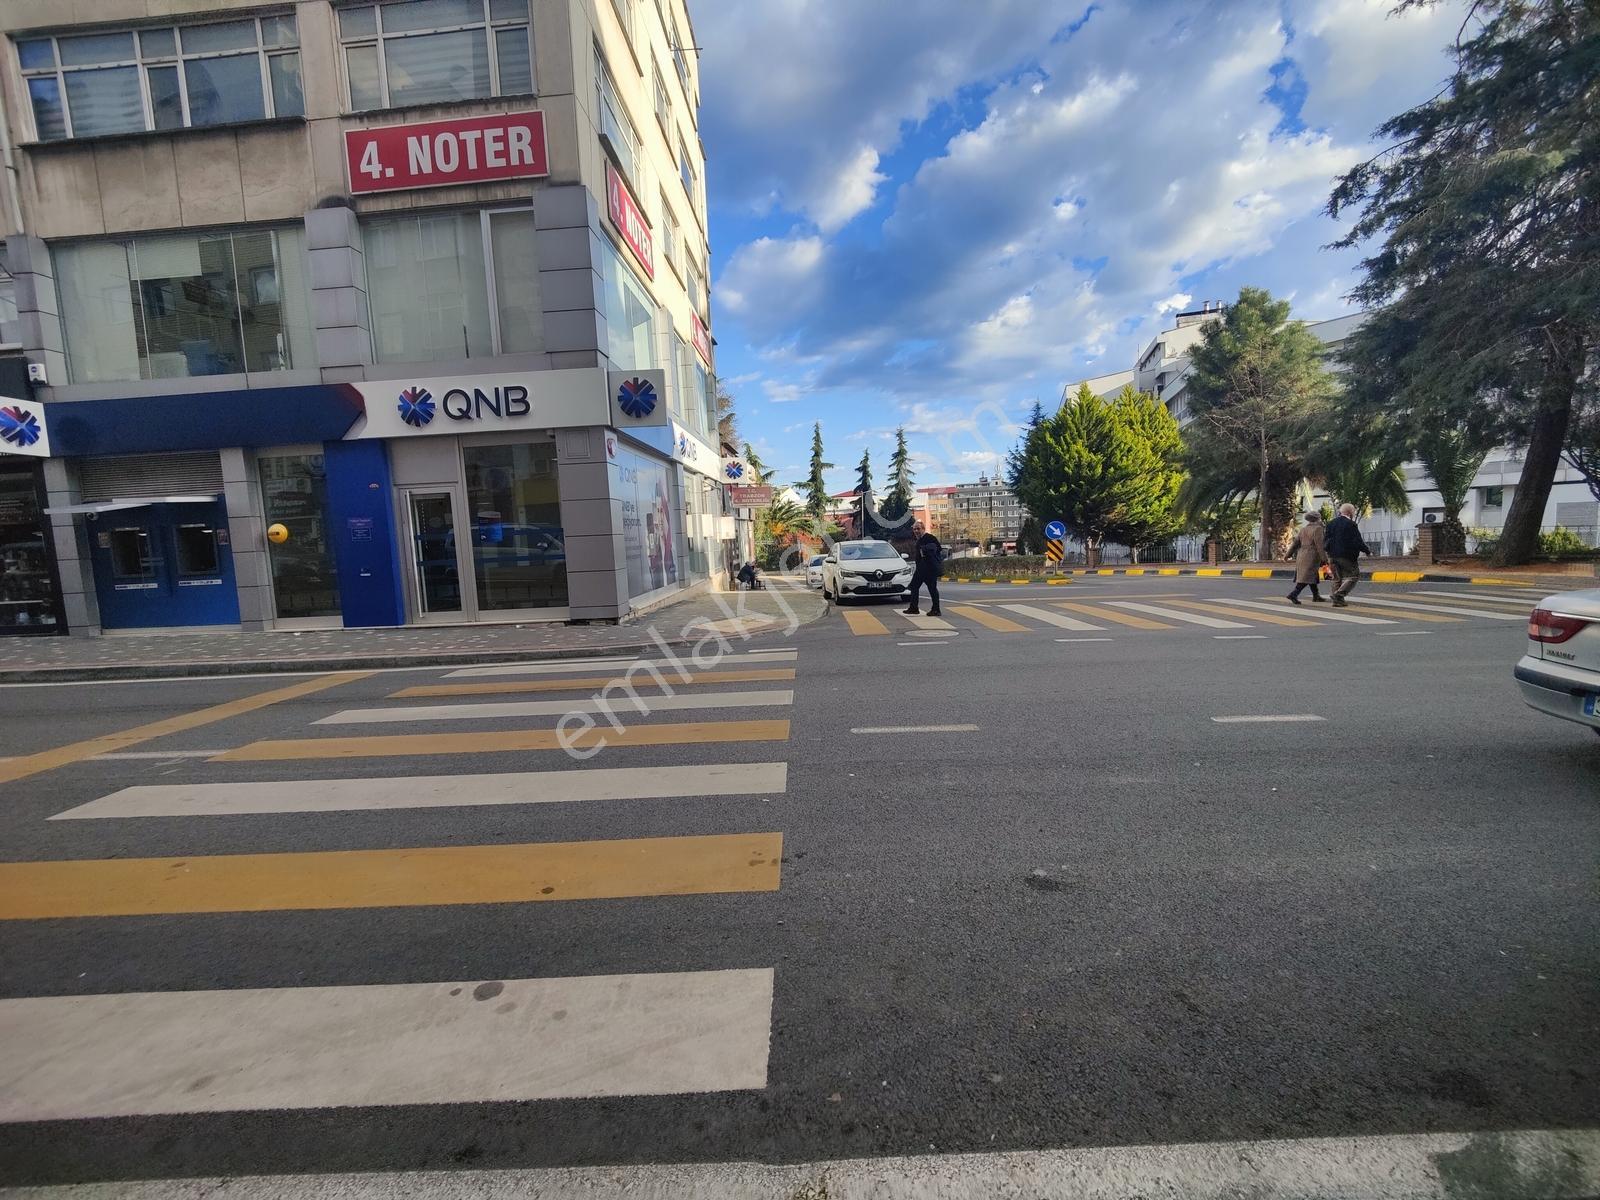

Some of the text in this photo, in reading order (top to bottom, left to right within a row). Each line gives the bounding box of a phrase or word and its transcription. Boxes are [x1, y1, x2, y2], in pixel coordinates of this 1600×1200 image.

[359, 126, 535, 179] 4. NOTER
[613, 183, 652, 269] 4. NOTER
[442, 385, 531, 421] QNB
